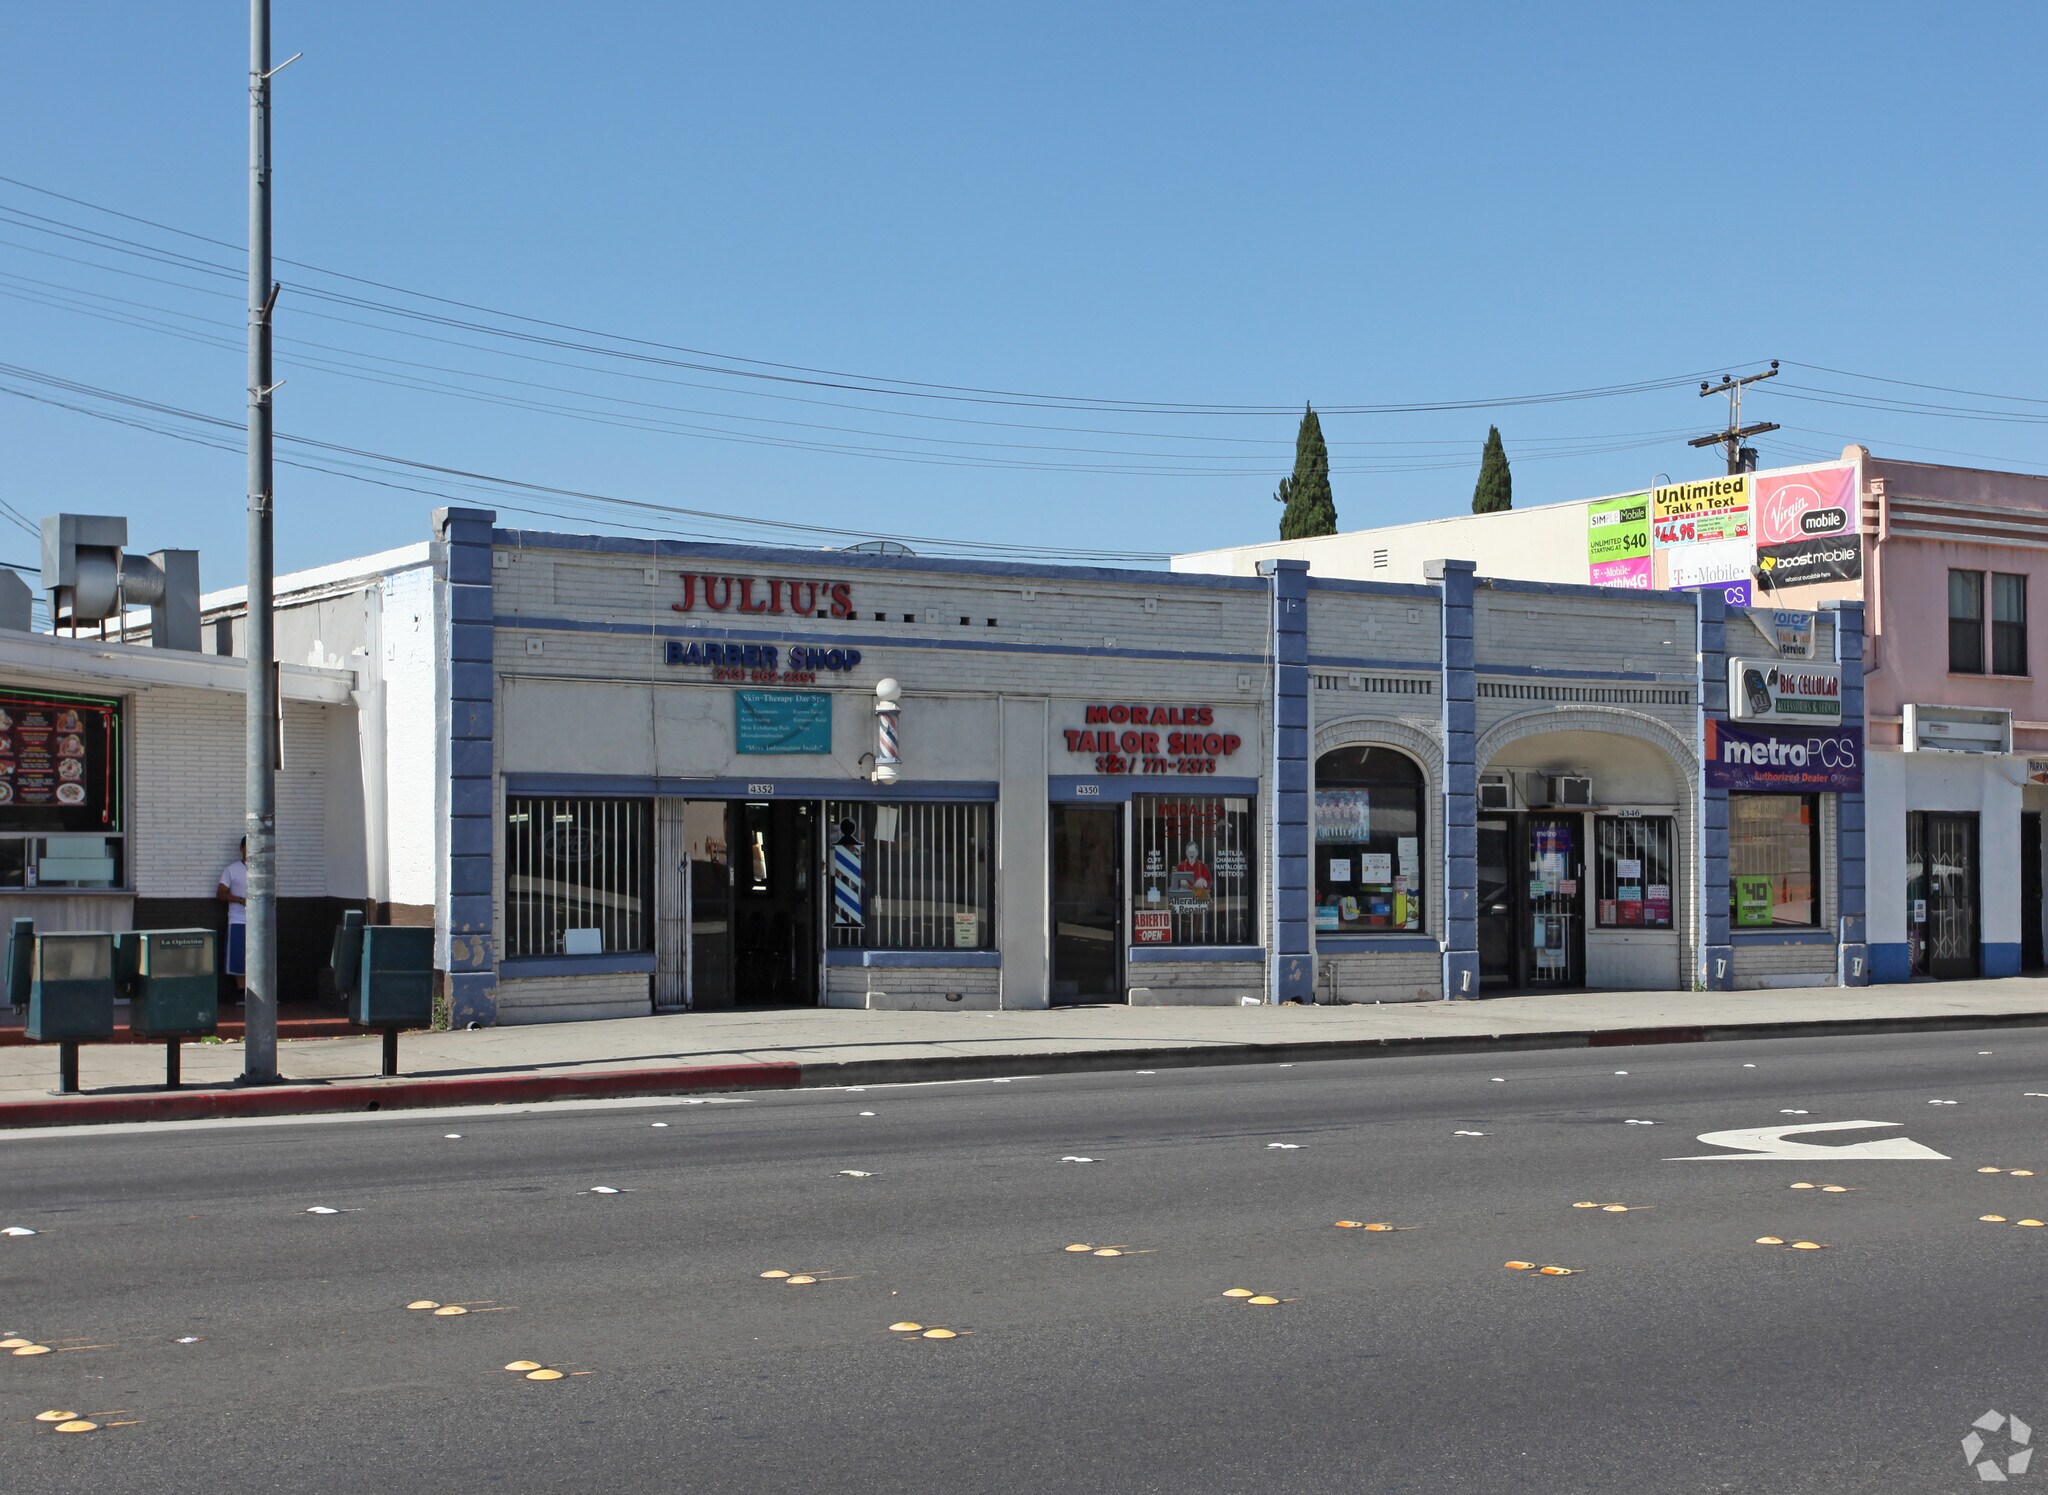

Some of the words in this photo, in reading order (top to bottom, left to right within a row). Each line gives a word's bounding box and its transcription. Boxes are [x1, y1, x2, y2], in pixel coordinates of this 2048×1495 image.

[1656, 477, 1744, 505] Unlimited
[1664, 502, 1692, 515] Talk
[1696, 502, 1703, 510] n
[1707, 496, 1735, 509] Text
[1770, 489, 1809, 534] Virgin
[1592, 512, 1619, 526] SIMPLE
[1620, 508, 1645, 521] Mobile
[1805, 512, 1841, 529] mobile
[1591, 537, 1622, 548] UNLIMITED
[1623, 532, 1647, 552] $40
[1591, 546, 1614, 554] STARTING
[672, 574, 853, 616] JULIU'S
[664, 641, 779, 668] BARBER
[788, 646, 862, 671] SHOP
[1782, 644, 1806, 655] Service
[712, 667, 746, 681] (213)
[1780, 674, 1795, 694] BIG
[1797, 674, 1838, 696] CELLULAR
[743, 694, 760, 702] Skin
[763, 694, 793, 703] Therapy
[796, 695, 810, 703] Day
[811, 695, 825, 703] Spa
[1776, 699, 1811, 712] ACCESSORIES
[1086, 705, 1214, 726] MORALES
[1064, 730, 1160, 754] TAILOR
[1168, 733, 1242, 755] SHOP
[1143, 757, 1217, 774] 771-2373
[1754, 771, 1800, 784] Authorized
[1801, 772, 1829, 783] Dealer
[750, 784, 773, 794] 4352
[1077, 785, 1098, 795] 4350
[1158, 803, 1225, 817] MORALES
[1618, 809, 1641, 818] 4346
[1171, 896, 1212, 906] Alterations
[1171, 905, 1178, 914] &
[1179, 904, 1209, 915] Repairs
[1135, 913, 1170, 928] ABIERTO
